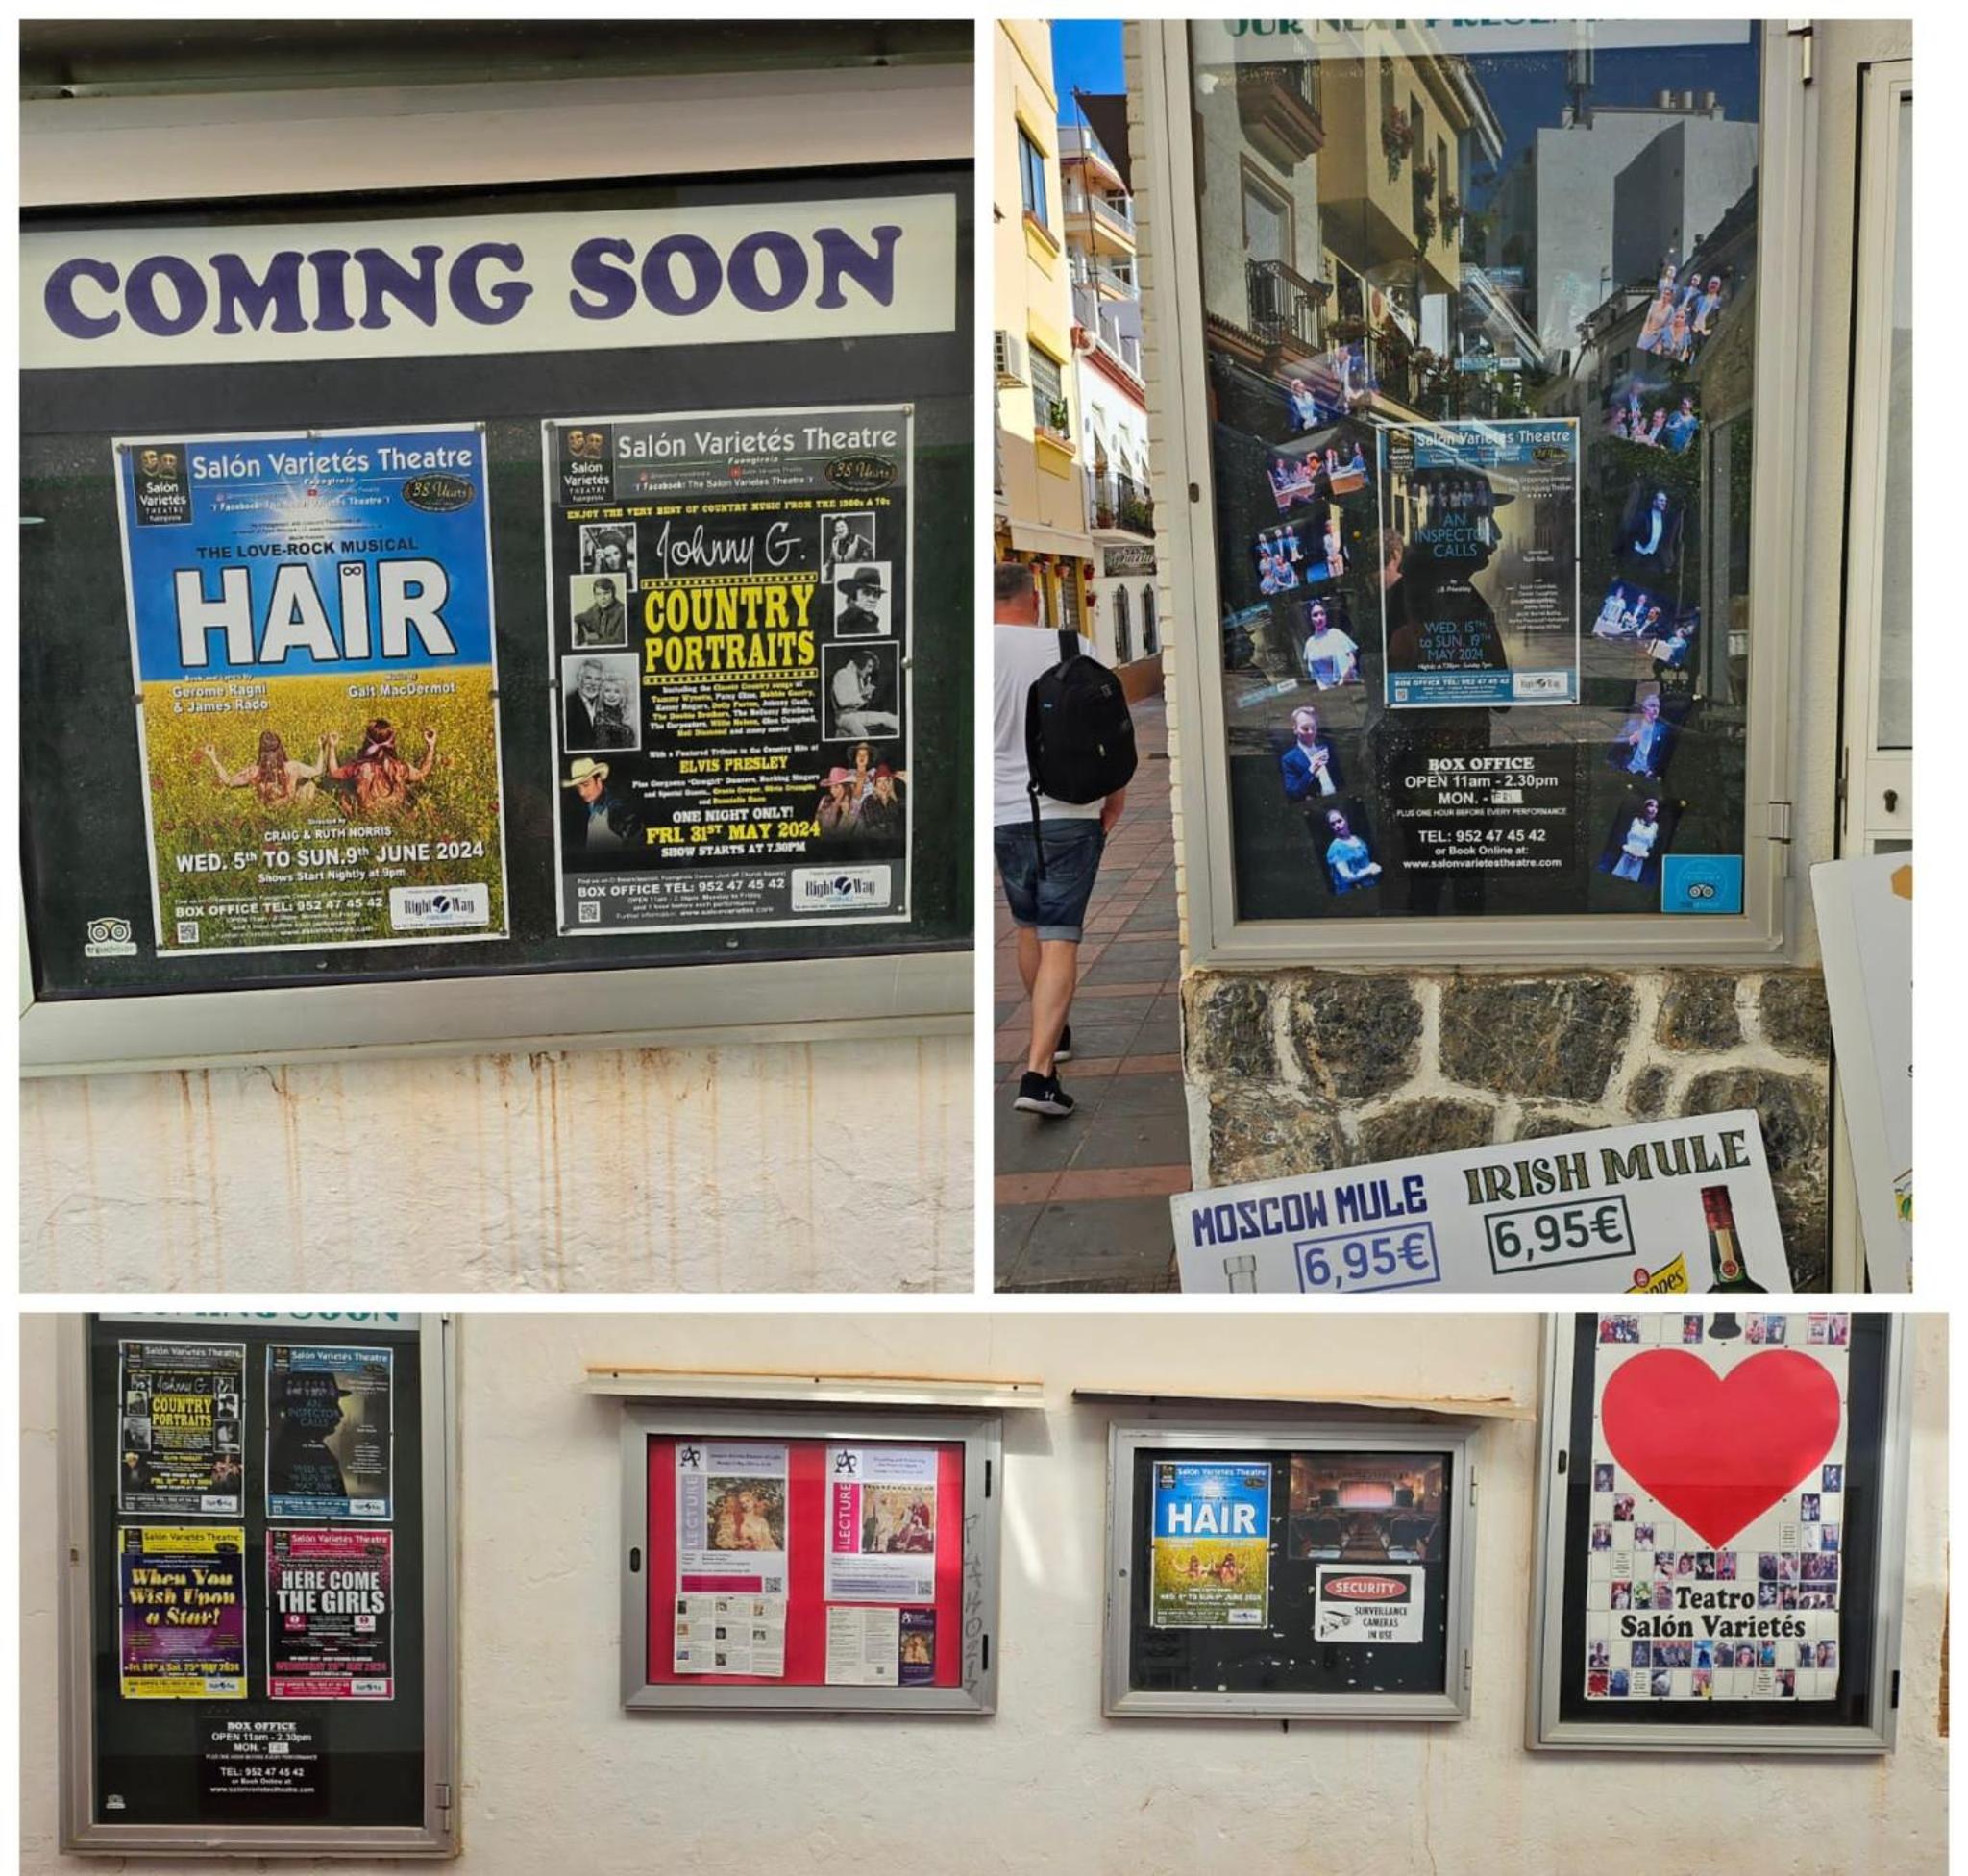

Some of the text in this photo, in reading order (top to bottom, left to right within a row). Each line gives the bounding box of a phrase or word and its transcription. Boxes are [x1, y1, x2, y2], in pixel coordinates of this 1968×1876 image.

[44, 225, 903, 339] COMING SOON
[618, 426, 898, 459] Salón Varietés Theatre
[1519, 430, 1570, 443] Theatre
[193, 446, 473, 479] Salón Varietés Theatre
[571, 461, 603, 474] Salón
[146, 481, 179, 494] Salón
[563, 474, 610, 486] Varietés
[139, 494, 187, 506] Varietés
[567, 498, 837, 520] ENJOY THE VERY BEST OF COUNTRY MUSIC FROM THE
[1443, 514, 1467, 526] AN
[196, 537, 419, 559] THE LOVE-ROCK MUSICAL
[656, 520, 806, 580] Johnny G.
[1433, 543, 1478, 557] CALLS
[644, 584, 815, 634] COUNTRY
[1424, 622, 1460, 633] WED.
[1419, 637, 1433, 649] to
[1436, 636, 1465, 648] SUN.
[645, 630, 815, 673] PORTRAITS
[1427, 649, 1484, 661] MAY 2024
[172, 683, 267, 699] Gerome Ragni
[380, 681, 456, 697] MacDermot
[173, 699, 269, 713] & James Rado
[679, 755, 789, 774] ELVIS PRESLEY
[1428, 757, 1535, 770] BOX OFFICE
[1404, 774, 1559, 790] OPEN 11am 2.30pm
[1438, 792, 1478, 805] MON.
[673, 806, 794, 824] ONE NIGHT ONLY!
[1396, 807, 1567, 817] PLUS ONE HOUR BEFORE EVERY PERFORMANCE
[264, 826, 392, 842] CRAIG & RUTH NORRIS
[646, 820, 821, 845] FRI. 31ST MAY 2024
[1418, 829, 1546, 843] TEL: 952 47 45 42
[176, 841, 484, 873] WED. 5th TO JUNE 2024
[661, 841, 806, 858] SHOW STARTS AT 7.30PM
[1435, 847, 1445, 855] or
[1449, 846, 1476, 855] Book
[1478, 845, 1513, 855] Online
[1403, 858, 1562, 869] www.salonvarietestheatre.com
[258, 873, 294, 884] Shows
[297, 871, 325, 882] Start
[328, 869, 366, 881] Nightly
[578, 877, 785, 898] BOX OFFICE TEL: 952 47 45 42
[175, 906, 205, 918] BOX
[208, 903, 259, 916] OFFICE
[262, 901, 293, 913] TEL:
[297, 901, 322, 912] 952
[325, 899, 343, 909] 47
[346, 898, 363, 908] 45
[367, 897, 383, 908] 42
[1463, 1130, 1751, 1205] IRISH MULE
[1192, 1174, 1428, 1247] MOSCOW MULE
[1494, 1205, 1623, 1263] 6,95€
[1304, 1232, 1430, 1289] 6,95€
[153, 1397, 211, 1413] COUNTRY
[152, 1413, 211, 1426] PORTRAITS
[838, 1483, 852, 1545] LECTURE
[1168, 1503, 1257, 1534] HAIR
[131, 1568, 234, 1586] When You
[281, 1570, 380, 1590] HERE COME
[1335, 1581, 1396, 1593] SECURITY
[129, 1587, 236, 1606] Wish Upon
[276, 1590, 385, 1615] THE GIRLS
[1676, 1586, 1755, 1609] Teatro
[145, 1606, 221, 1626] a Star!
[1354, 1606, 1408, 1616] SURVEILLANCE
[1363, 1617, 1399, 1627] CAMERAS
[1621, 1614, 1806, 1638] Salón Varietés
[1367, 1630, 1392, 1639] IN USE
[227, 1721, 297, 1731] BOX OFFICE
[211, 1732, 240, 1741] OPEN
[243, 1732, 269, 1741] 11am
[219, 1766, 305, 1777] TEL: 952 47 45 42
